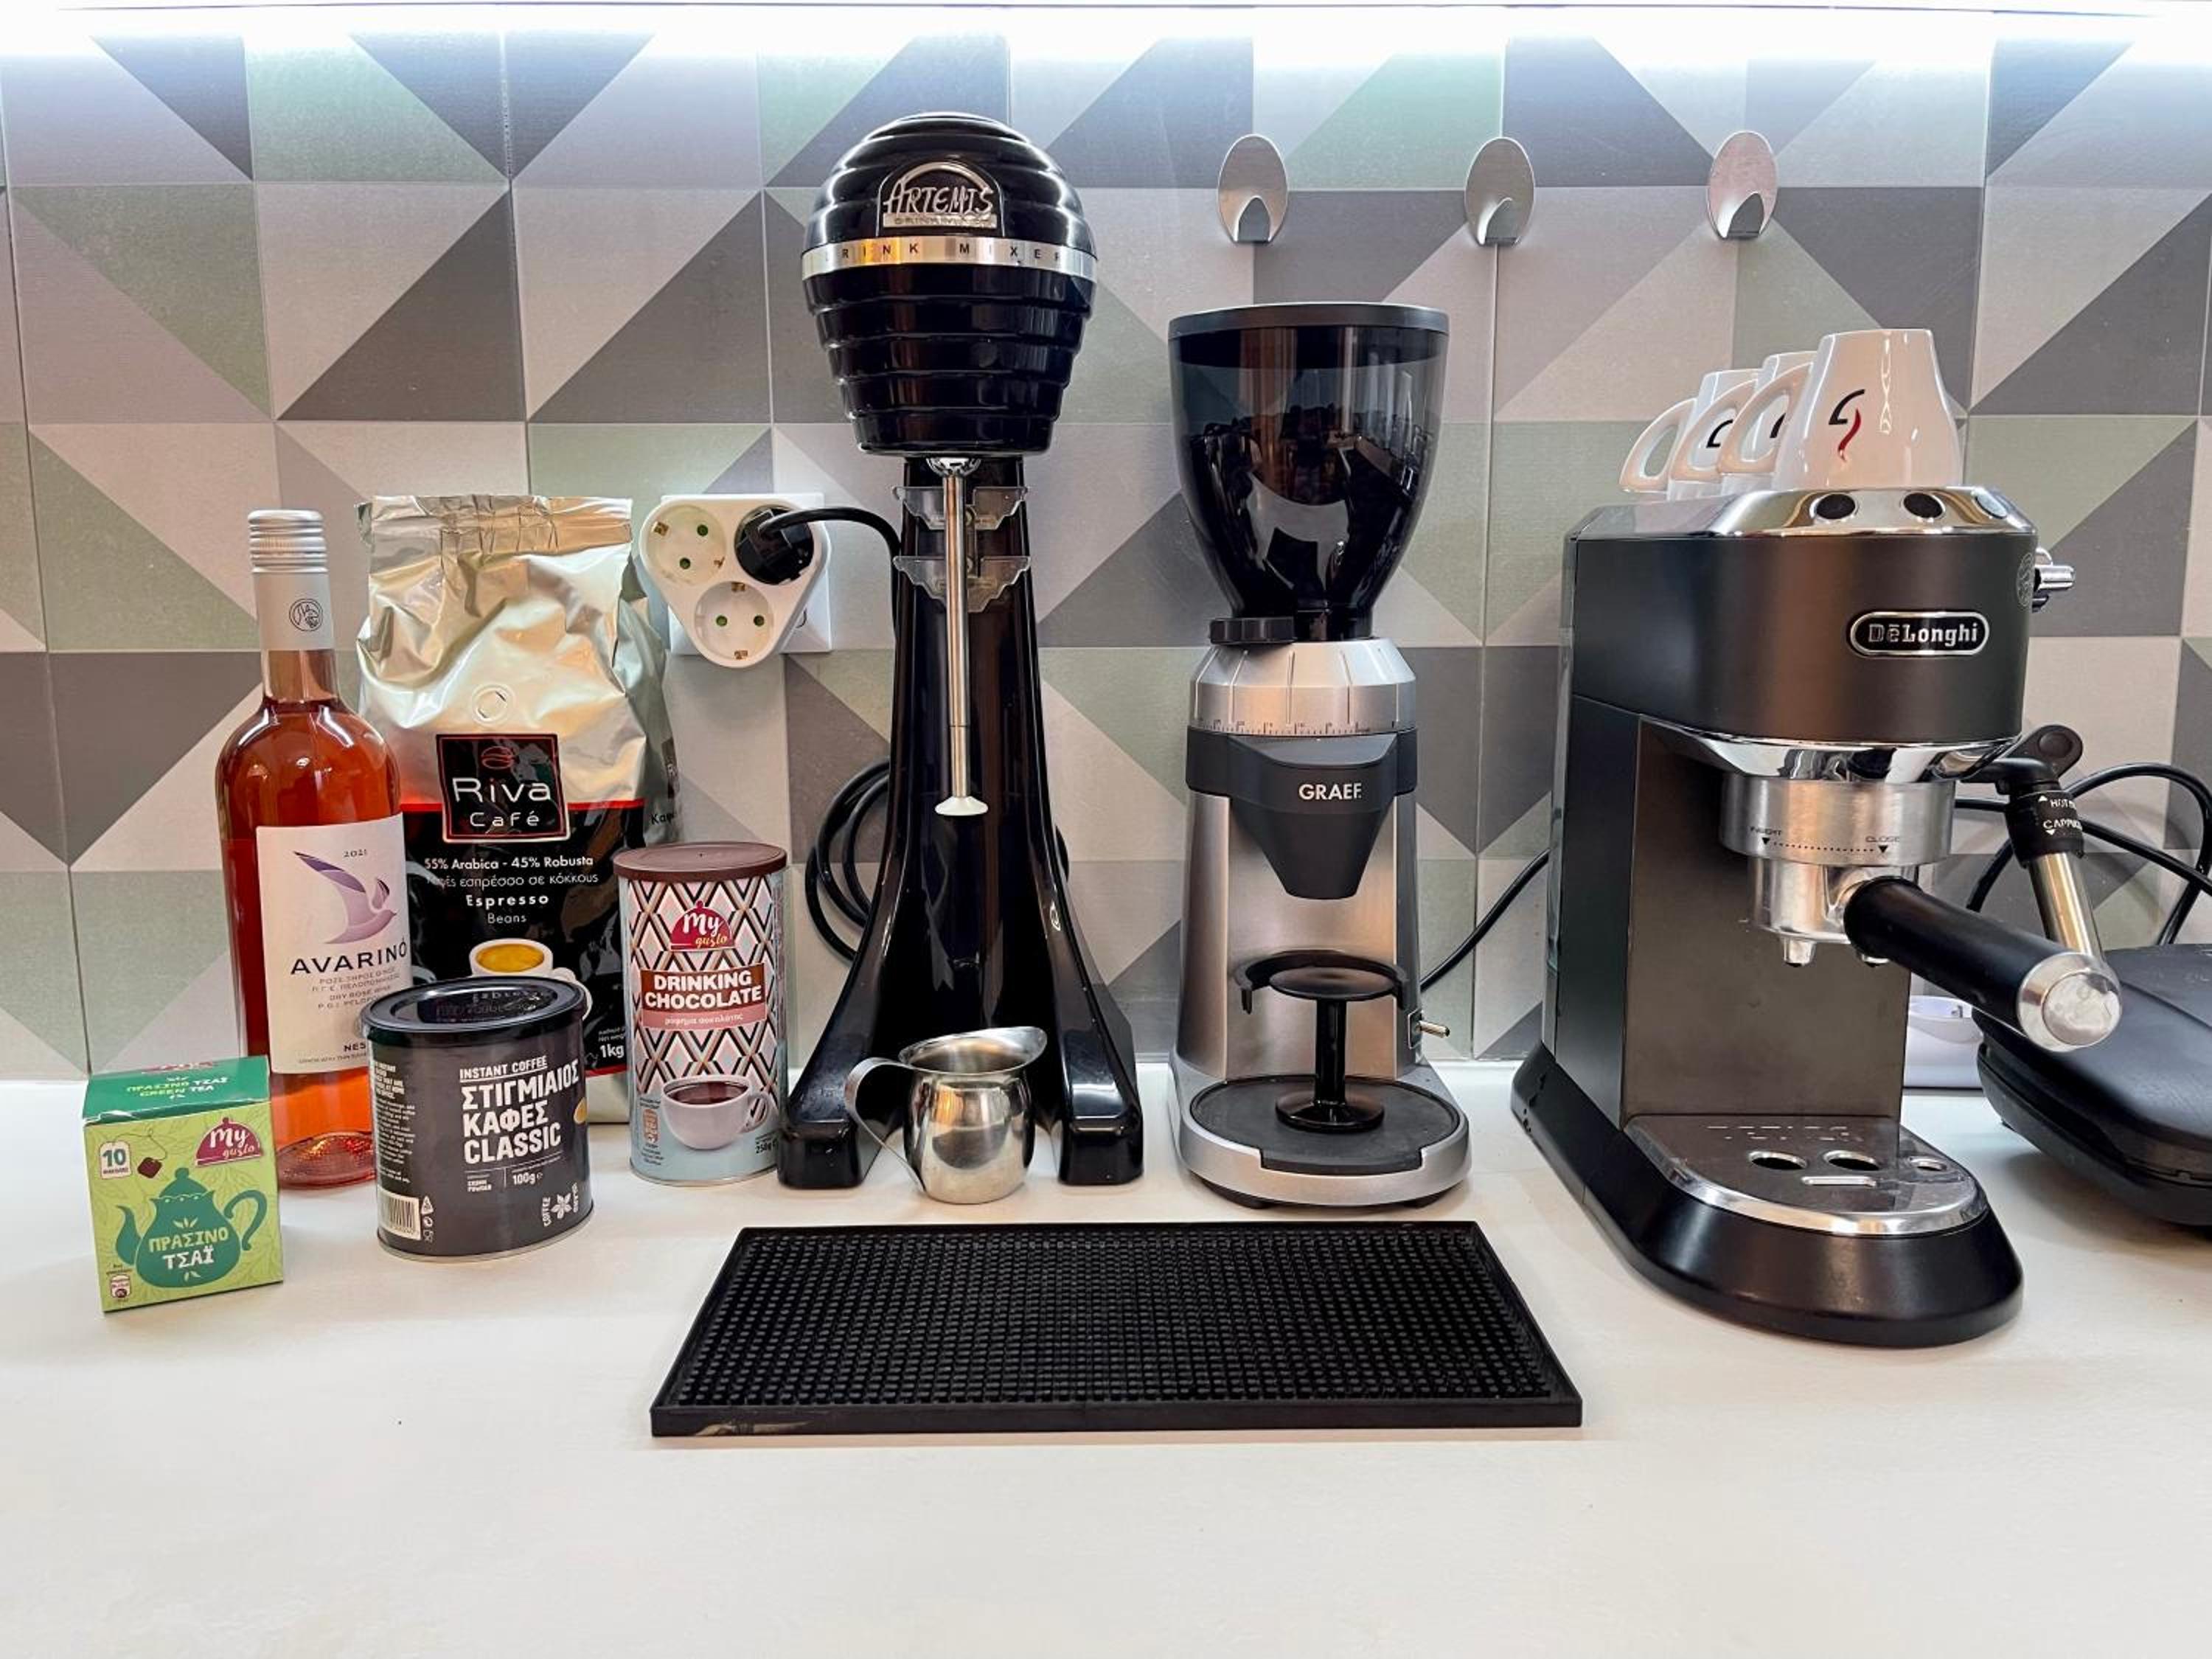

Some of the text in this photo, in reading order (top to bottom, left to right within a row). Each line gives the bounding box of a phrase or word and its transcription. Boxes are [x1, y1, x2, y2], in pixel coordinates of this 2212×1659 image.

[883, 179, 994, 215] ARTEMIS
[825, 243, 919, 262] RINK
[452, 777, 551, 803] Riva
[1298, 782, 1362, 800] GRAEF
[470, 810, 540, 827] Café
[424, 858, 449, 870] 55%
[451, 858, 499, 870] Arabica
[511, 856, 540, 869] 45%
[543, 855, 594, 868] Robusta
[529, 875, 546, 886] σε
[465, 894, 549, 911] Espresso
[487, 912, 527, 924] Beans
[683, 912, 726, 936] My
[695, 933, 728, 949] gusto
[654, 970, 752, 991] DRINKING
[645, 985, 762, 1009] CHOCOLATE
[344, 1042, 367, 1052] NES
[599, 1043, 625, 1059] 1kg
[459, 1055, 548, 1079] INSTANT COFFEE
[461, 1058, 579, 1110] ΣΤΙΓΜΙΑΙΟΣ
[462, 1099, 549, 1138] ΚΑΦΕΣ
[209, 1127, 248, 1149] My
[465, 1122, 561, 1164] CLASSIC
[102, 1149, 126, 1167] 10
[223, 1144, 254, 1159] gusto
[512, 1172, 536, 1185] 100g
[149, 1227, 229, 1253] ΠΡΑΣΙΝΟ
[162, 1245, 215, 1270] ΤΣΑΪ
